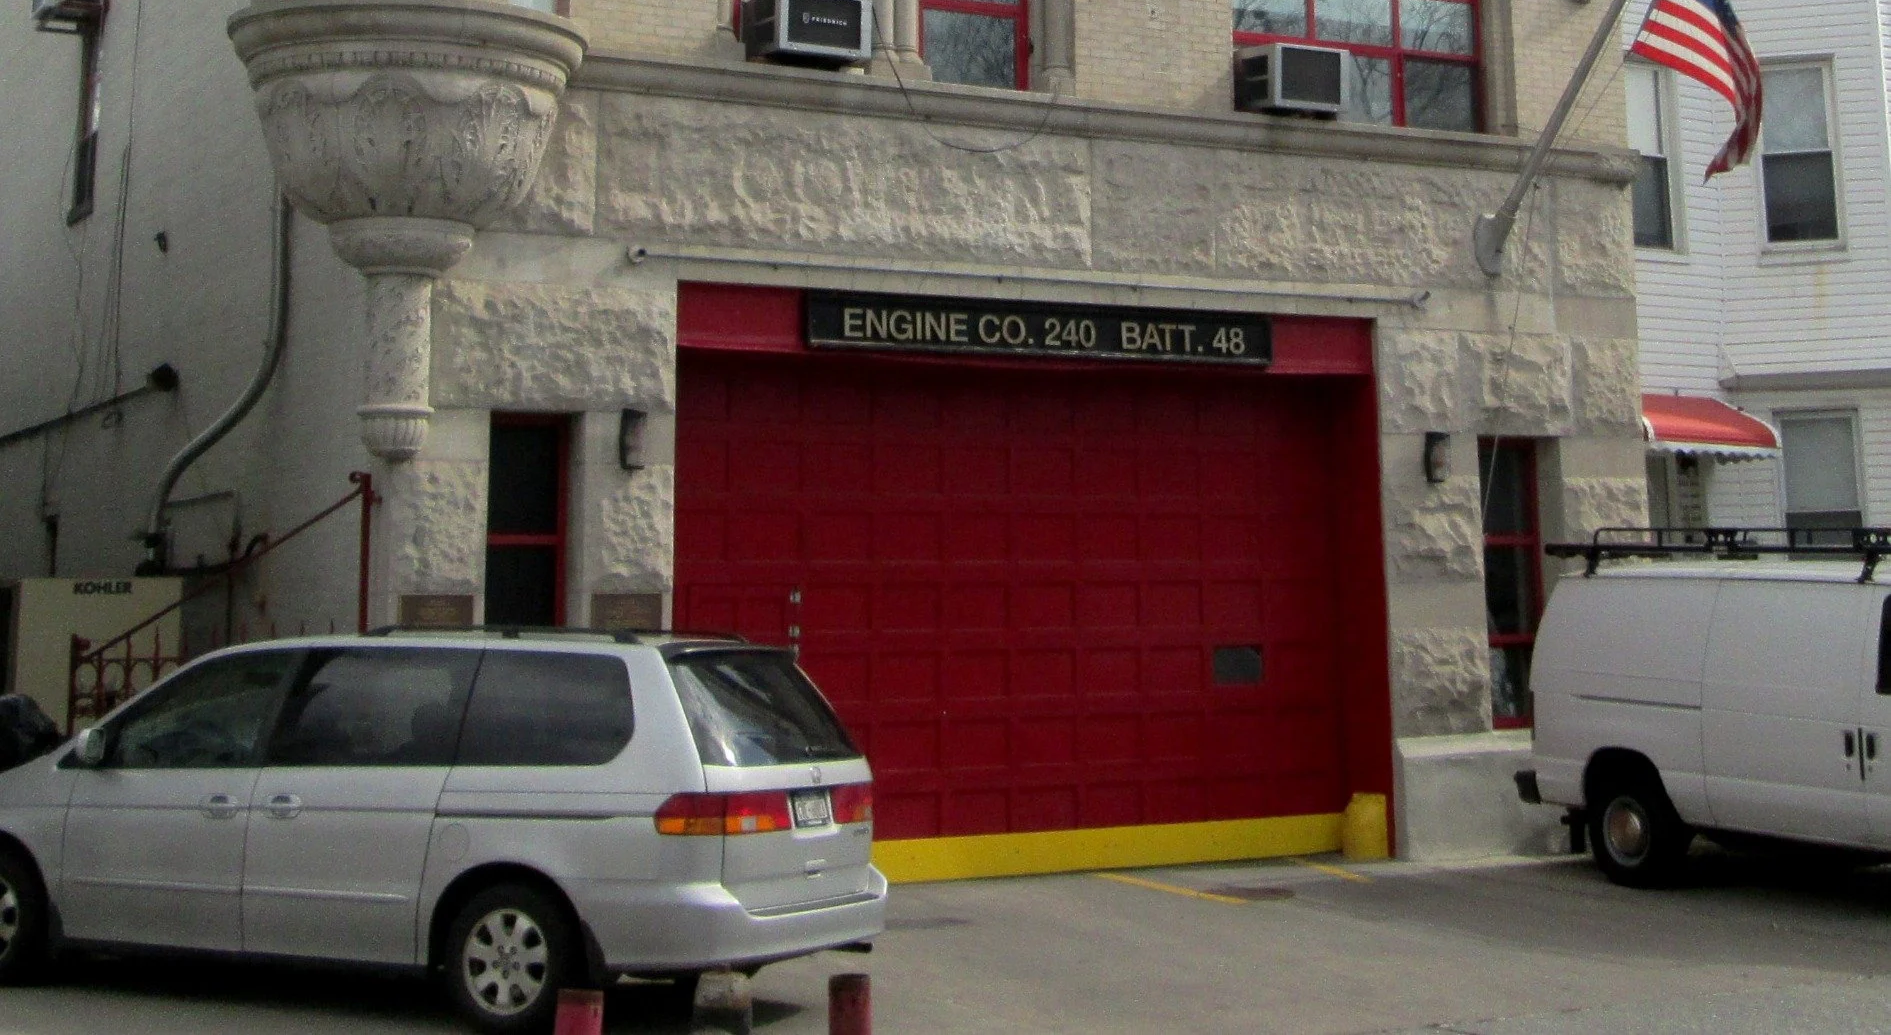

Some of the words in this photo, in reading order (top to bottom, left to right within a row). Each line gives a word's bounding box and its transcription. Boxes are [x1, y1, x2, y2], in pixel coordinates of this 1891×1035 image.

[811, 16, 848, 26] FRIEDRICH
[843, 308, 968, 342] ENGINE
[979, 316, 1033, 345] CO.
[1044, 319, 1096, 348] 240
[1121, 322, 1203, 353] BATT.
[1213, 327, 1245, 355] 48
[74, 582, 132, 595] KOHLER
